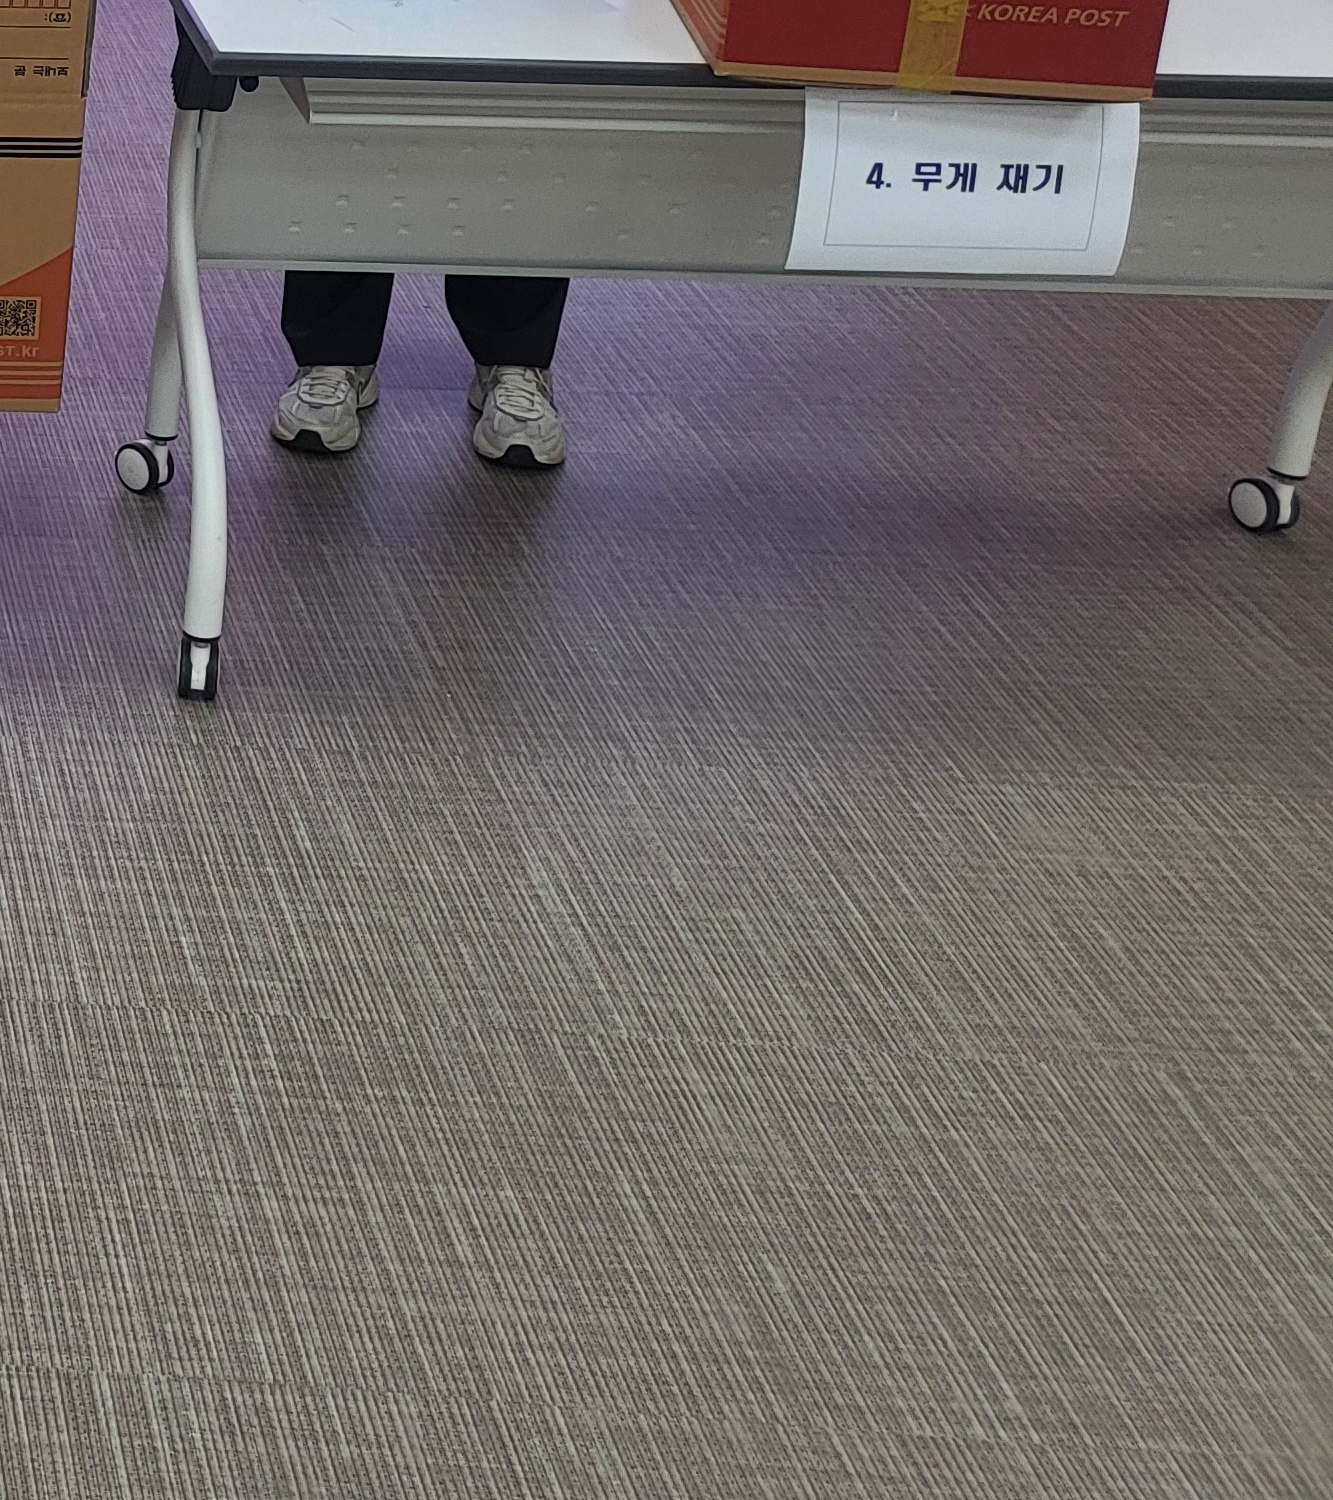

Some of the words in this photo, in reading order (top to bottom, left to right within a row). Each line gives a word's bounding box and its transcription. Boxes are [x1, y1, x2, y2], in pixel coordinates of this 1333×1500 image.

[977, 3, 1058, 24] KOREA
[1064, 8, 1130, 27] POST
[866, 163, 892, 190] 4.
[912, 163, 978, 193] 무게
[996, 164, 1064, 195] 재기
